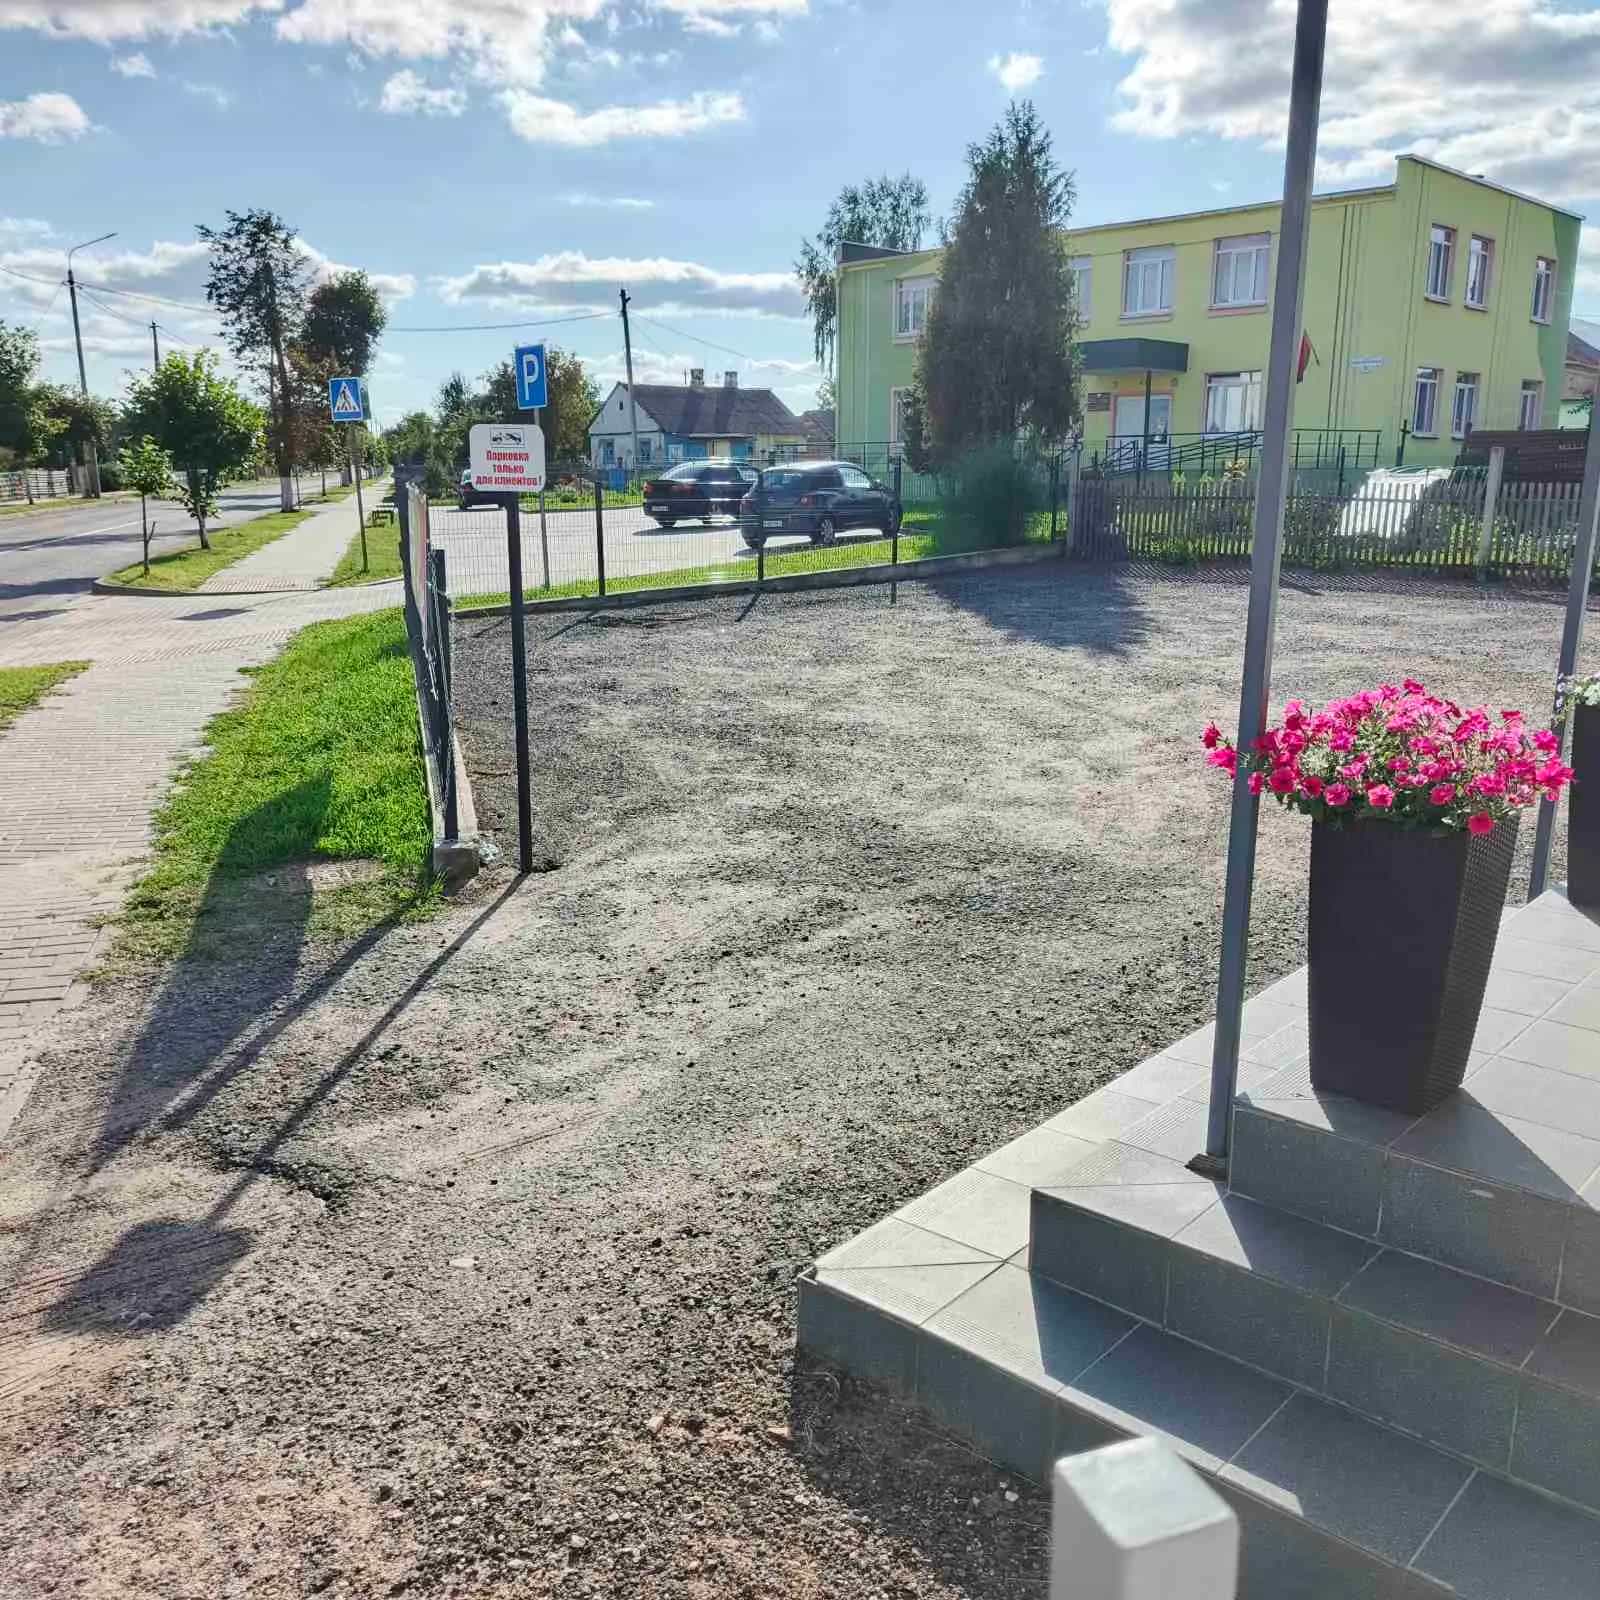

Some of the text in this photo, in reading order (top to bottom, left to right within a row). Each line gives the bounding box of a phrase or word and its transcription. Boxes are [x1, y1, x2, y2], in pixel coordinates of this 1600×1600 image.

[522, 353, 539, 400] P
[486, 450, 529, 461] Парковка
[475, 476, 493, 485] для
